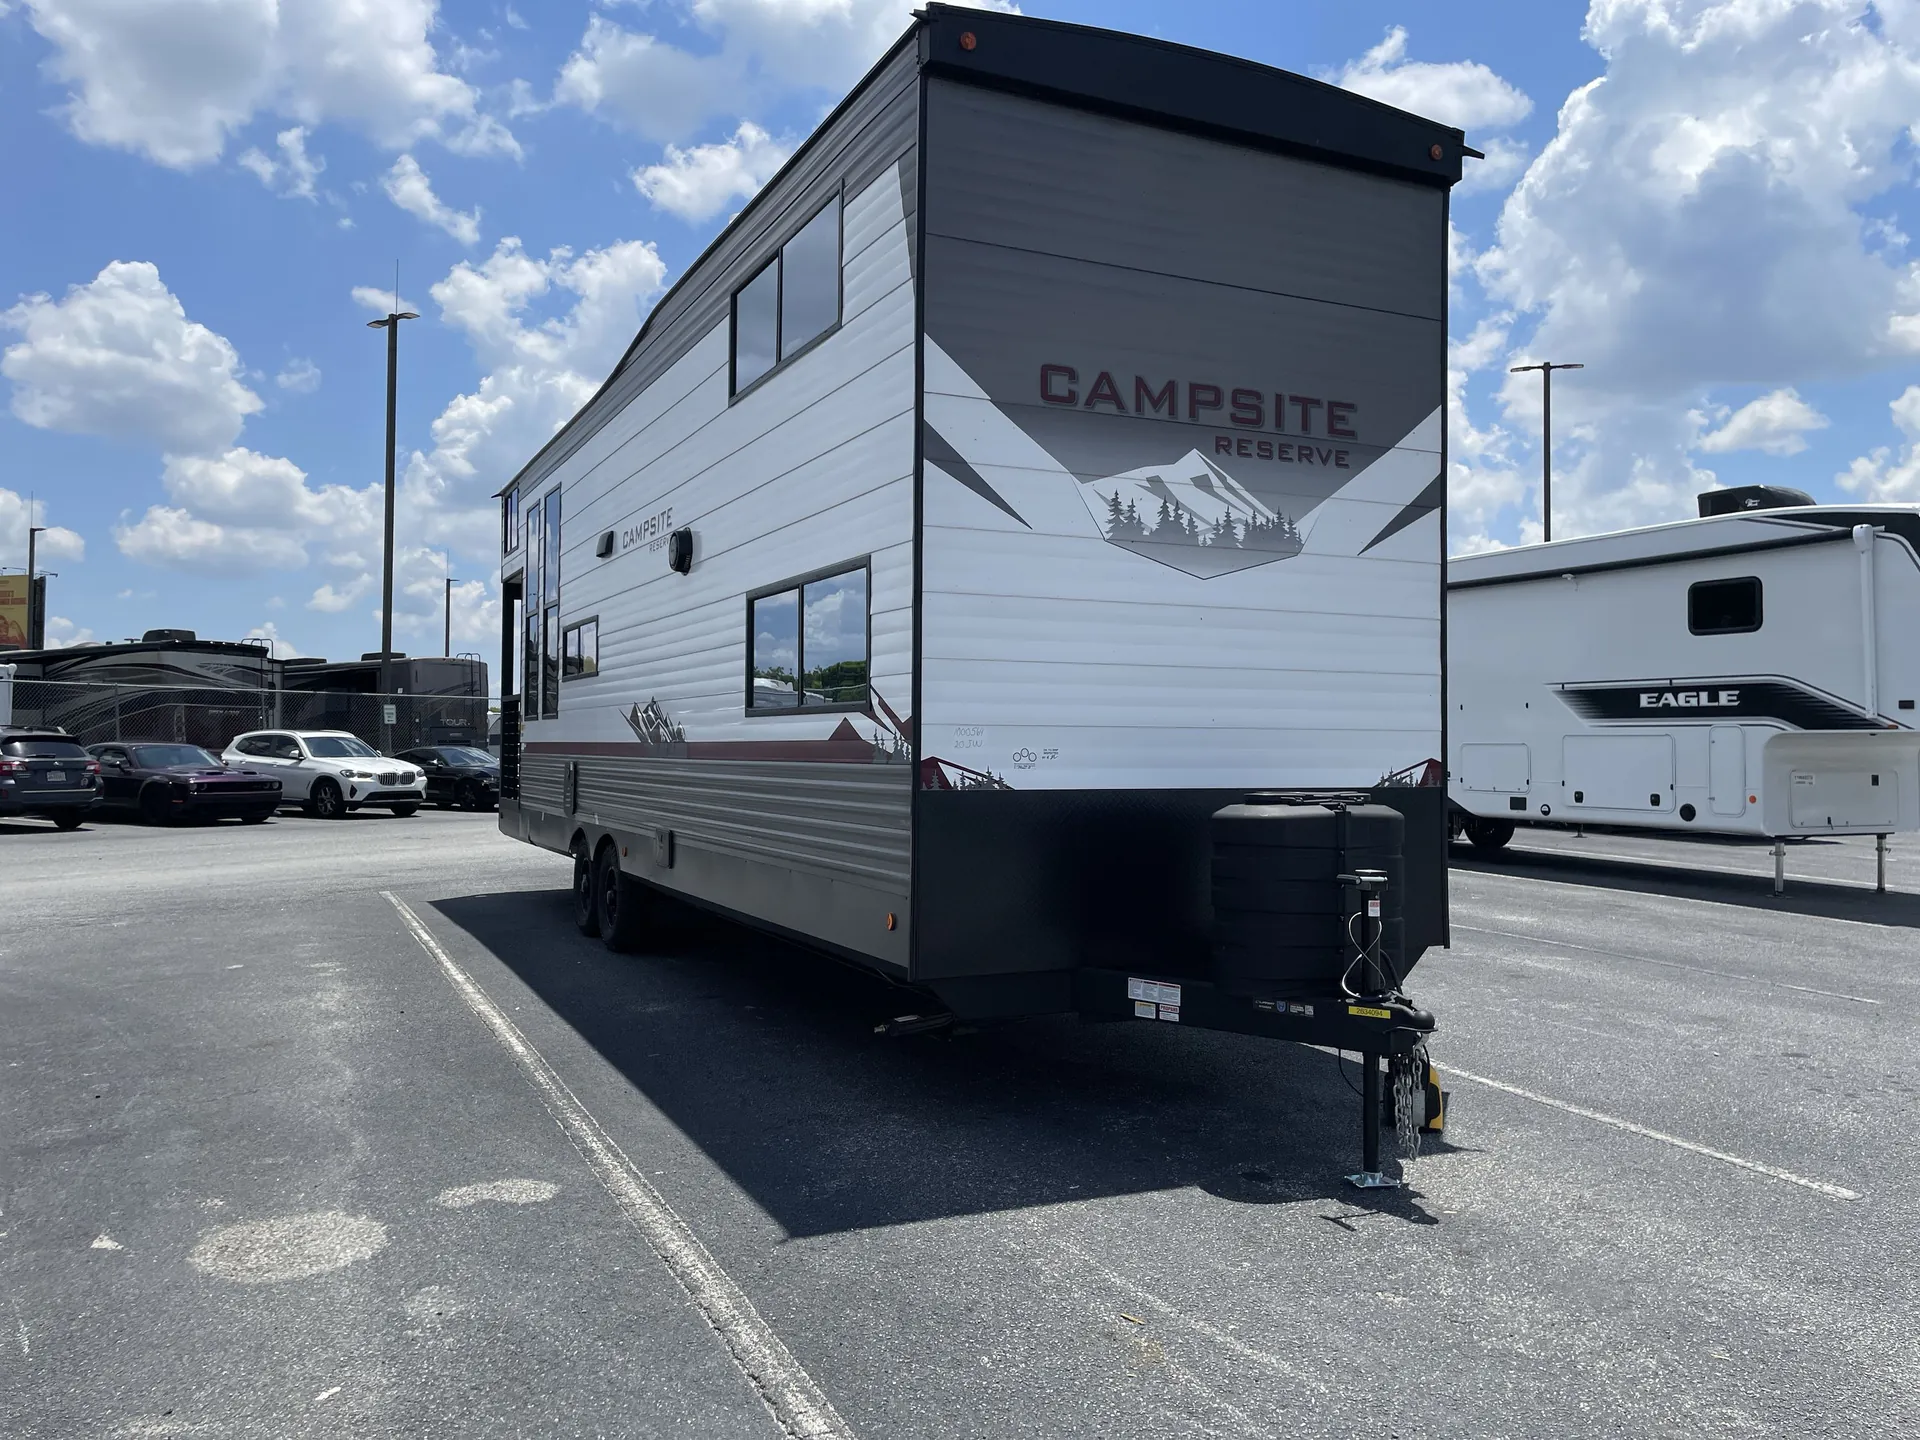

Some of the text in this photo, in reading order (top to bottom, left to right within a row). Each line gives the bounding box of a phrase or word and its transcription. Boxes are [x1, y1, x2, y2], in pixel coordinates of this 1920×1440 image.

[1039, 363, 1358, 438] CAMPSITE
[1214, 435, 1350, 469] RESERVE
[622, 507, 673, 548] CAMPSITE
[1639, 690, 1741, 708] EAGLE
